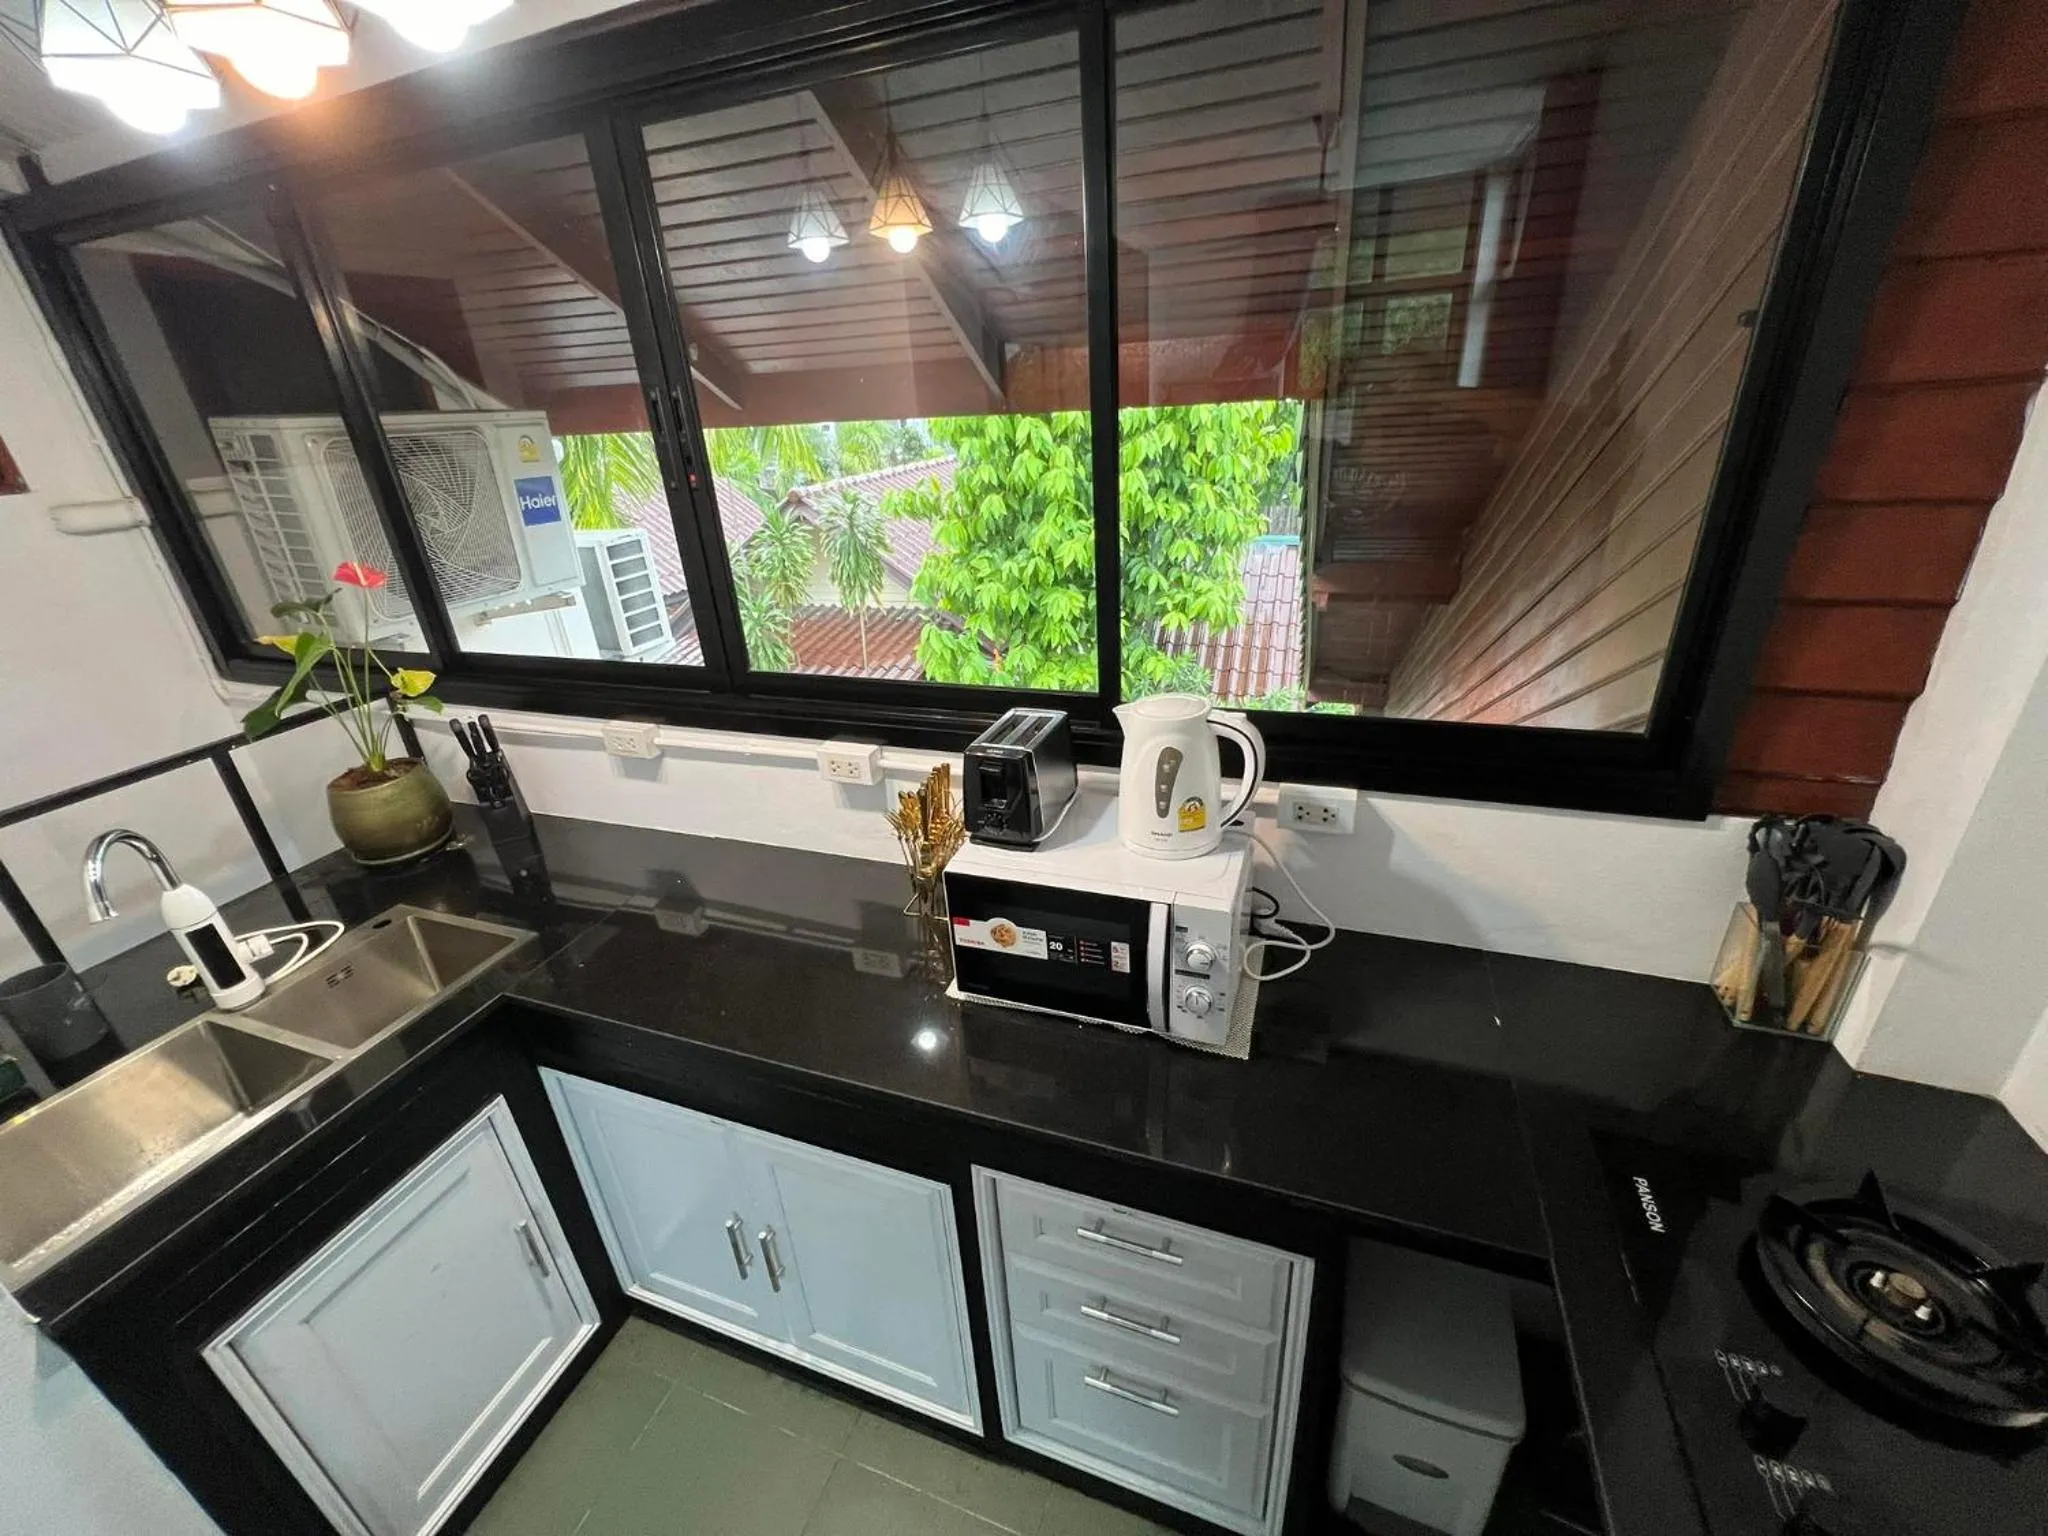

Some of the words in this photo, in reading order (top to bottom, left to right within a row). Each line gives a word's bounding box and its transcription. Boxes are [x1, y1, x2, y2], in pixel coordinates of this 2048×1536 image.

[520, 493, 558, 511] Haier
[1049, 941, 1063, 951] 20
[1632, 1176, 1666, 1233] PANSON
